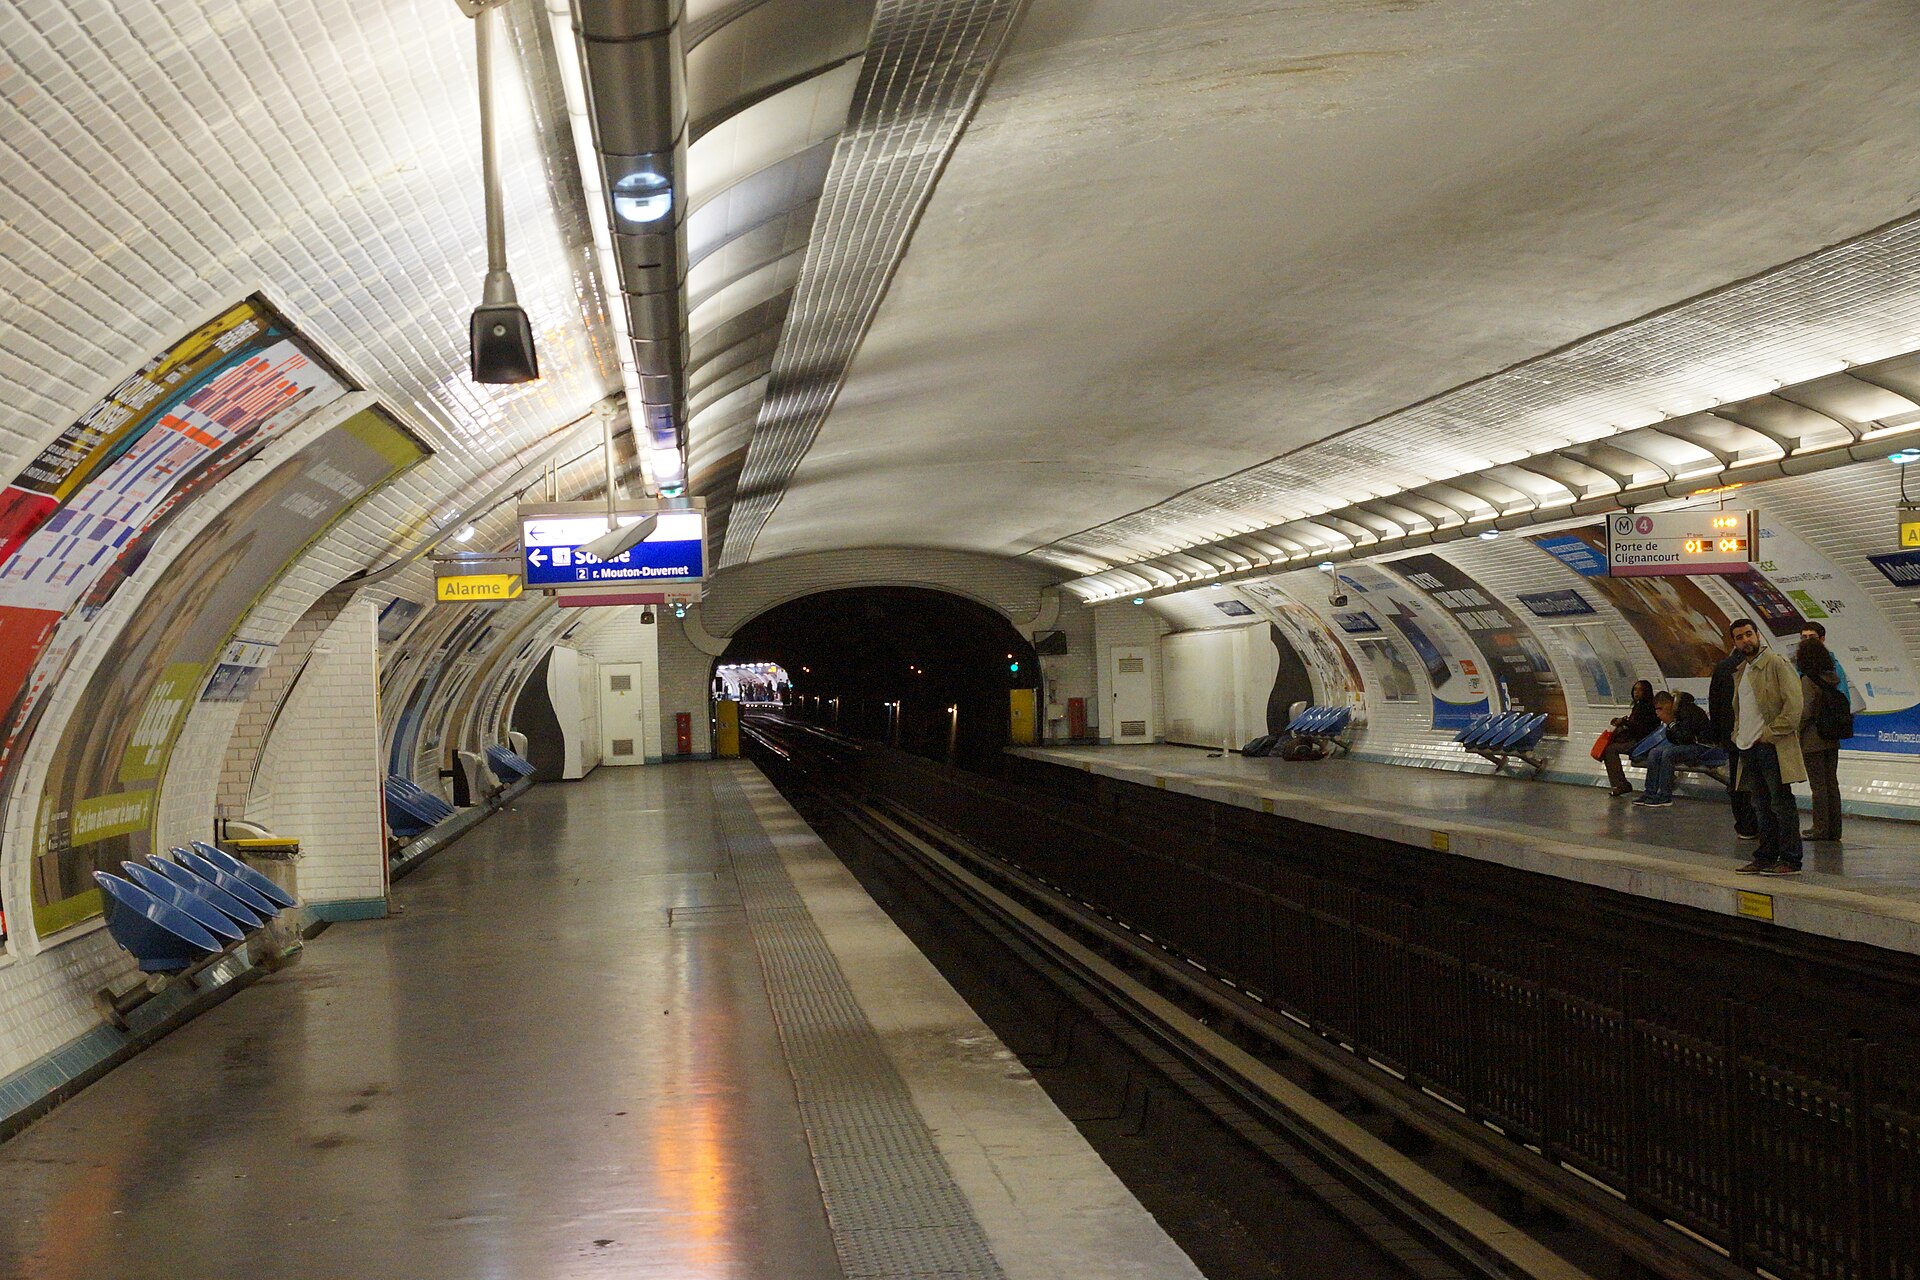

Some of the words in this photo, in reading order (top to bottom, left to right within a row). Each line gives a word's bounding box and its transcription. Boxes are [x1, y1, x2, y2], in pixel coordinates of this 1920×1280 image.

[107, 371, 165, 410] VOLTAIRE
[76, 398, 135, 434] ROUSSEAU
[1639, 519, 1648, 531] 4
[1615, 543, 1642, 552] Porte
[1645, 542, 1658, 551] de
[1685, 540, 1703, 553] 01
[1719, 538, 1738, 552] 04
[575, 551, 630, 565] Soe
[1615, 553, 1680, 565] Clignancourt
[592, 570, 600, 579] r.
[601, 566, 690, 578] Mouton-Duvernet
[445, 582, 500, 596] Alarme
